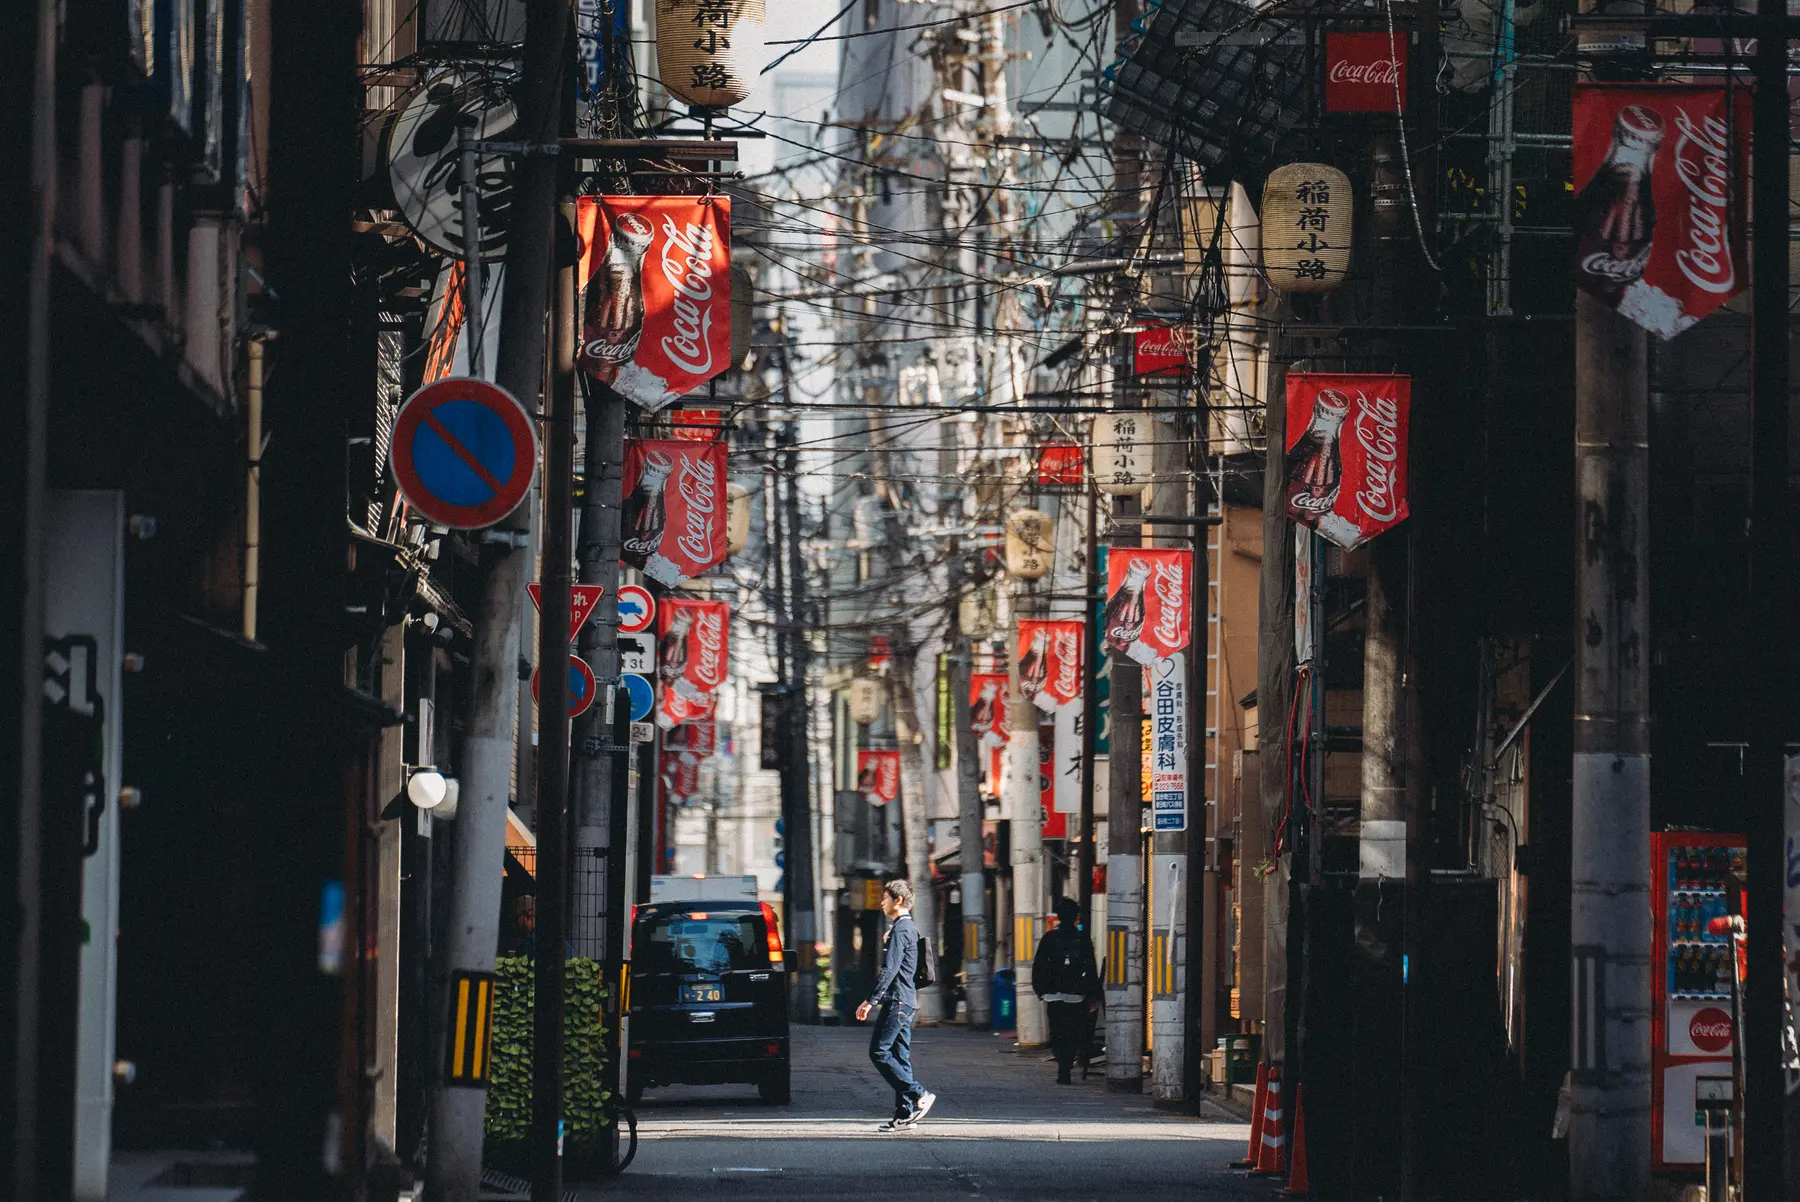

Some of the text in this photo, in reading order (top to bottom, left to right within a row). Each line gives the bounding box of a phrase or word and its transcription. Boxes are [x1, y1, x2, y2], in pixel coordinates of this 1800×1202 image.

[1329, 59, 1404, 85] Coca-Cola
[1295, 180, 1330, 280] 稲荷小路
[1674, 105, 1735, 293] Coca-Cola
[661, 212, 714, 375] Coca-Cola
[1112, 417, 1137, 486] 稲荷小路
[1356, 389, 1398, 522] Coca-Cola
[677, 451, 716, 564] Coca-Cola
[694, 608, 722, 685] Coca-Cola
[1153, 558, 1184, 648] Coca-Cola
[1156, 680, 1177, 770] 谷田皮膚科
